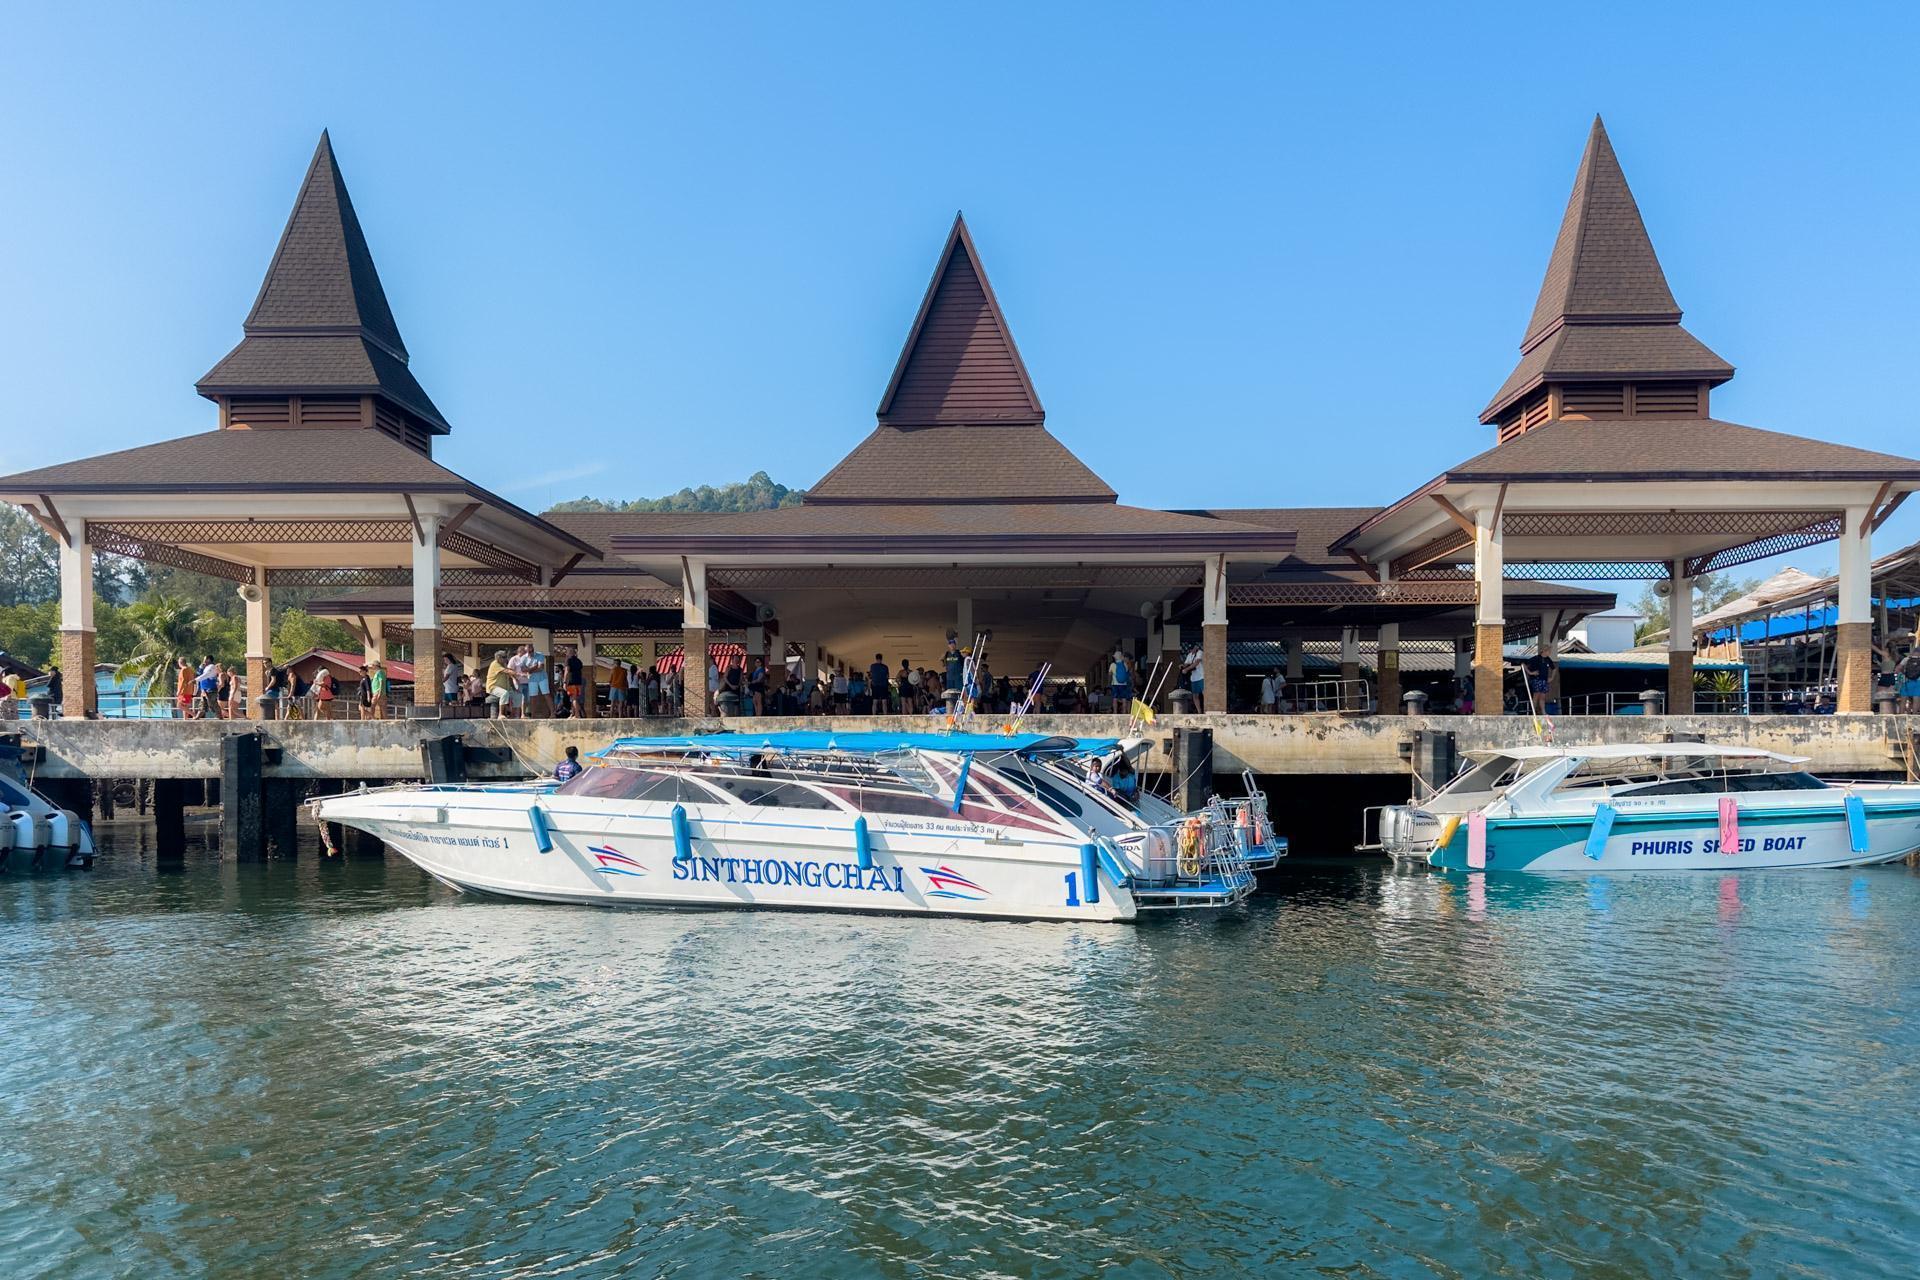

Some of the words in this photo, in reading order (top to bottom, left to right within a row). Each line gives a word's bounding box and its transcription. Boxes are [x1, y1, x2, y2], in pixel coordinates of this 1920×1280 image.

[926, 822, 935, 830] 33
[980, 825, 985, 833] 3
[503, 837, 509, 849] 1
[1631, 840, 1694, 855] PHURIS
[1702, 838, 1756, 854] SPED
[1763, 836, 1807, 851] BOAT
[671, 855, 905, 893] SINTHONGCHAI
[1064, 871, 1080, 907] 1
